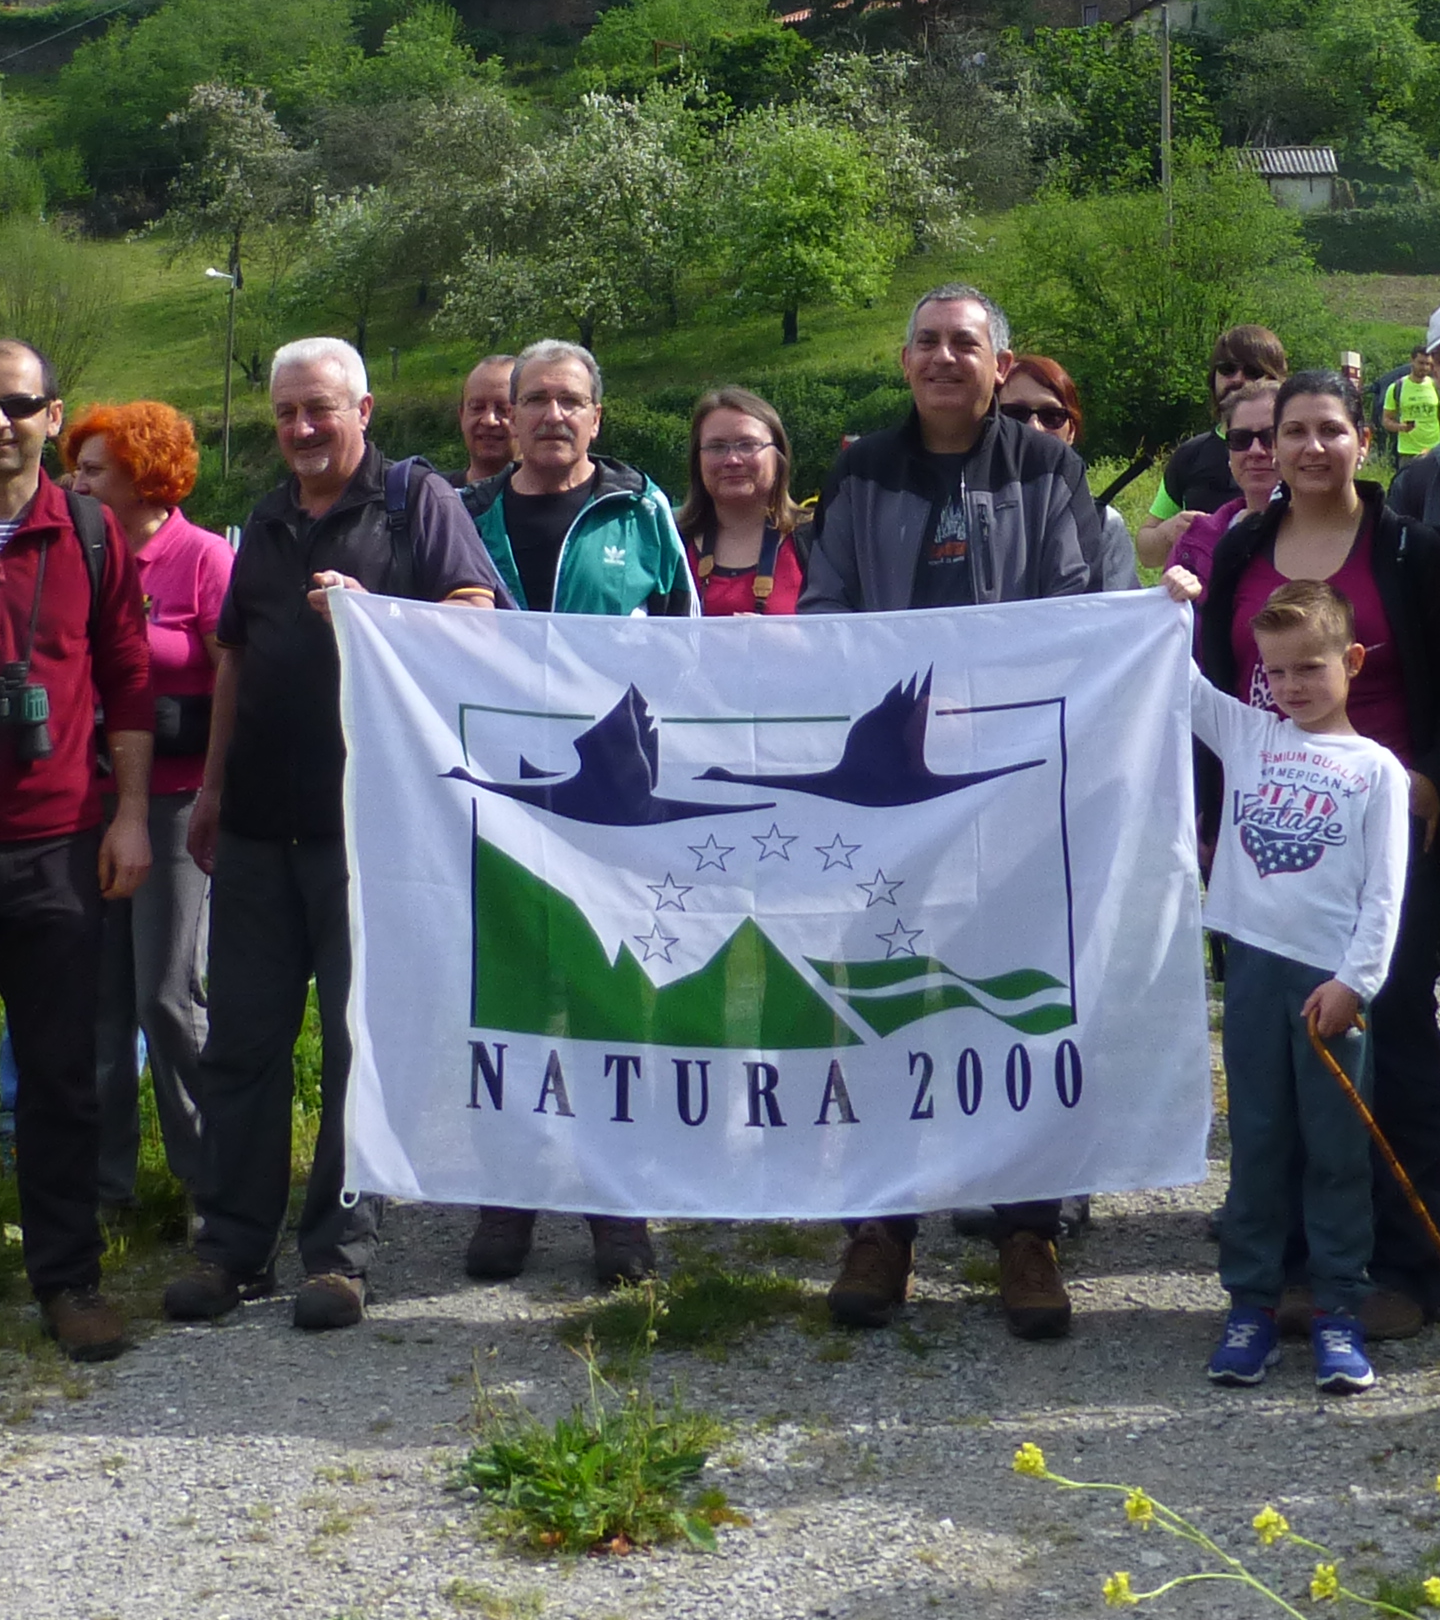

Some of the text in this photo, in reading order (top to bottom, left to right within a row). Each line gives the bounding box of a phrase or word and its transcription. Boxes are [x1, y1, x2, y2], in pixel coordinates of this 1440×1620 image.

[1267, 766, 1343, 790] AMERICAN
[1311, 754, 1370, 793] QUALITY
[1233, 789, 1345, 844] Vintage
[466, 1038, 1084, 1128] NATURA 2000
